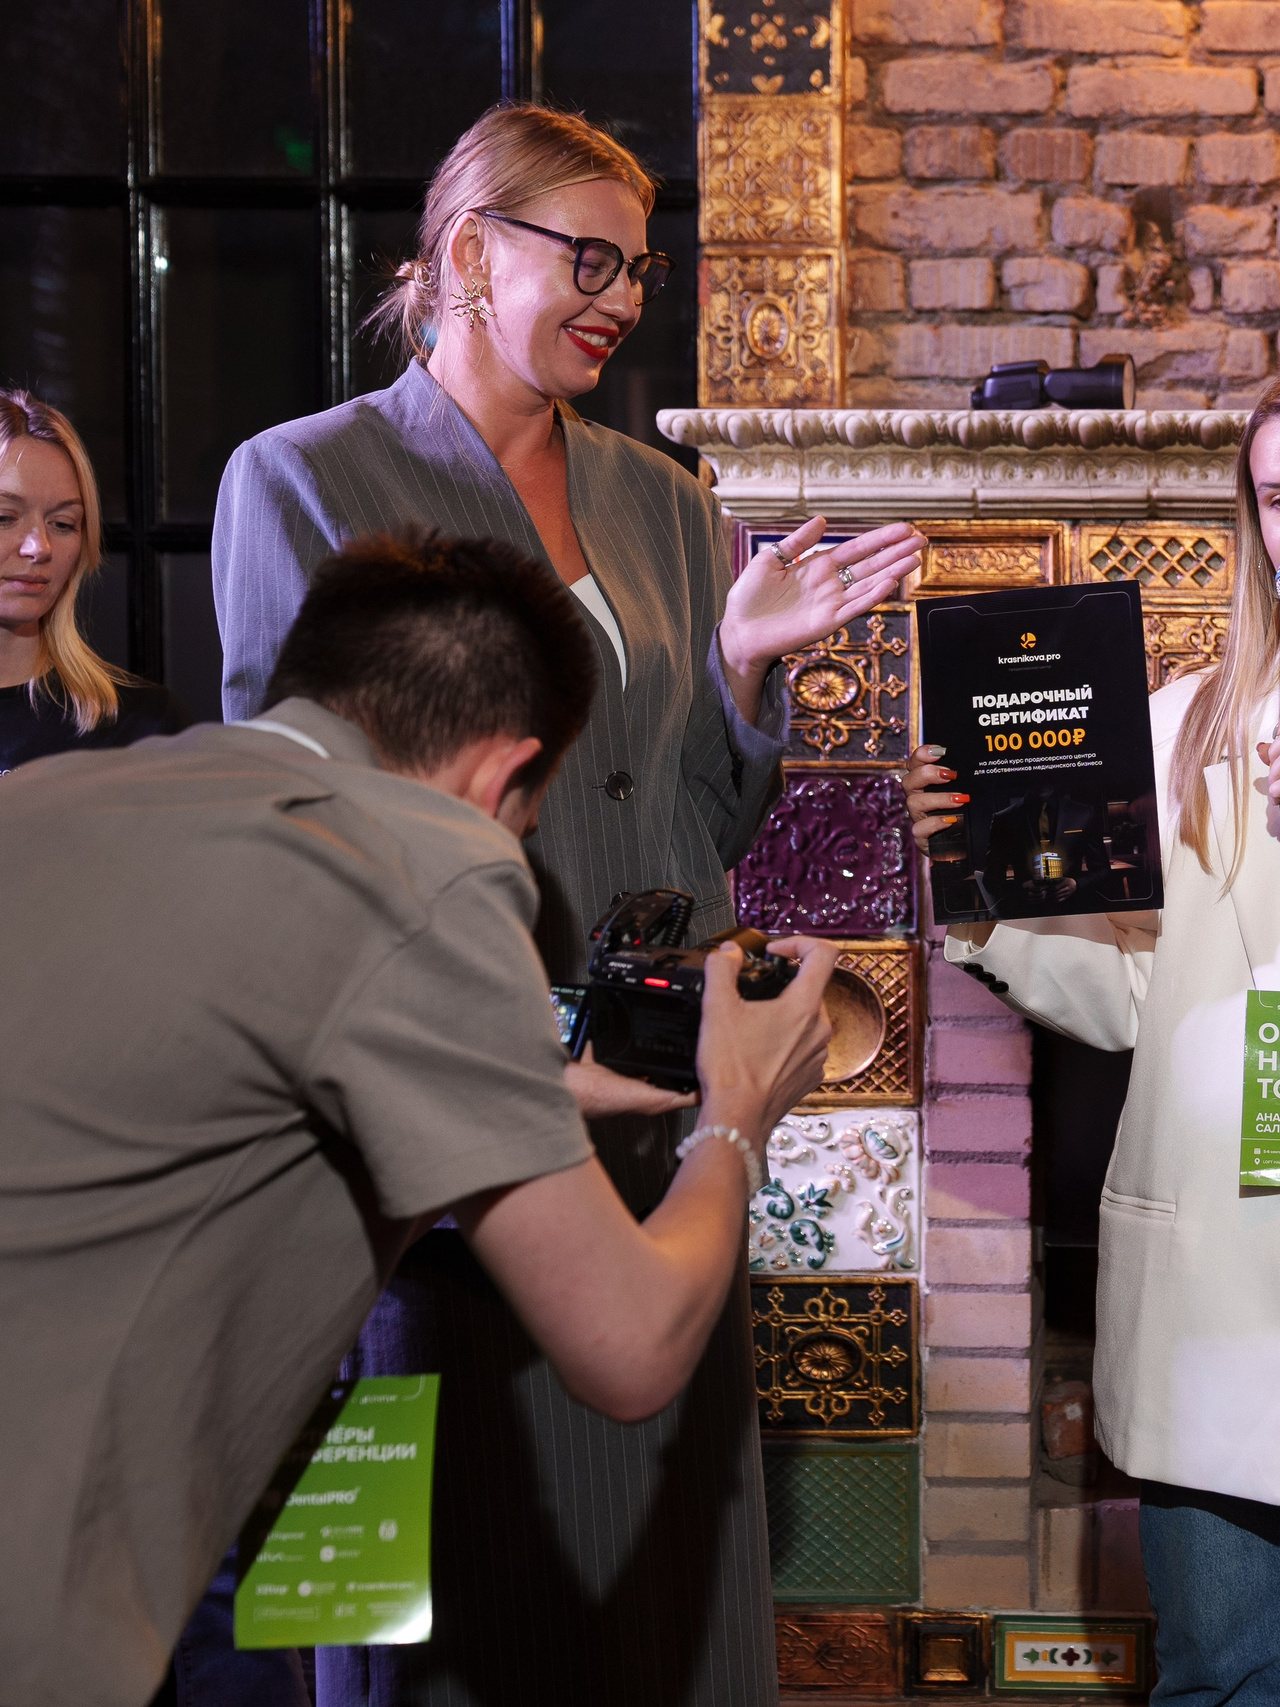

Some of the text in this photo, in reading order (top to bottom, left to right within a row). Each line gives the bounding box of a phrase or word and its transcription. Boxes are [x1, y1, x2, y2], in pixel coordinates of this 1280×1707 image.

[998, 653, 1061, 665] krasnikova.pro
[972, 684, 1093, 708] ПОДАРОЧНЫЙ
[978, 706, 1089, 726] СЕРТИФИКАТ
[985, 728, 1086, 752] 100 000₽
[1024, 754, 1073, 763] продюсерского
[986, 766, 1032, 774] собственников
[1033, 762, 1076, 770] медицинского
